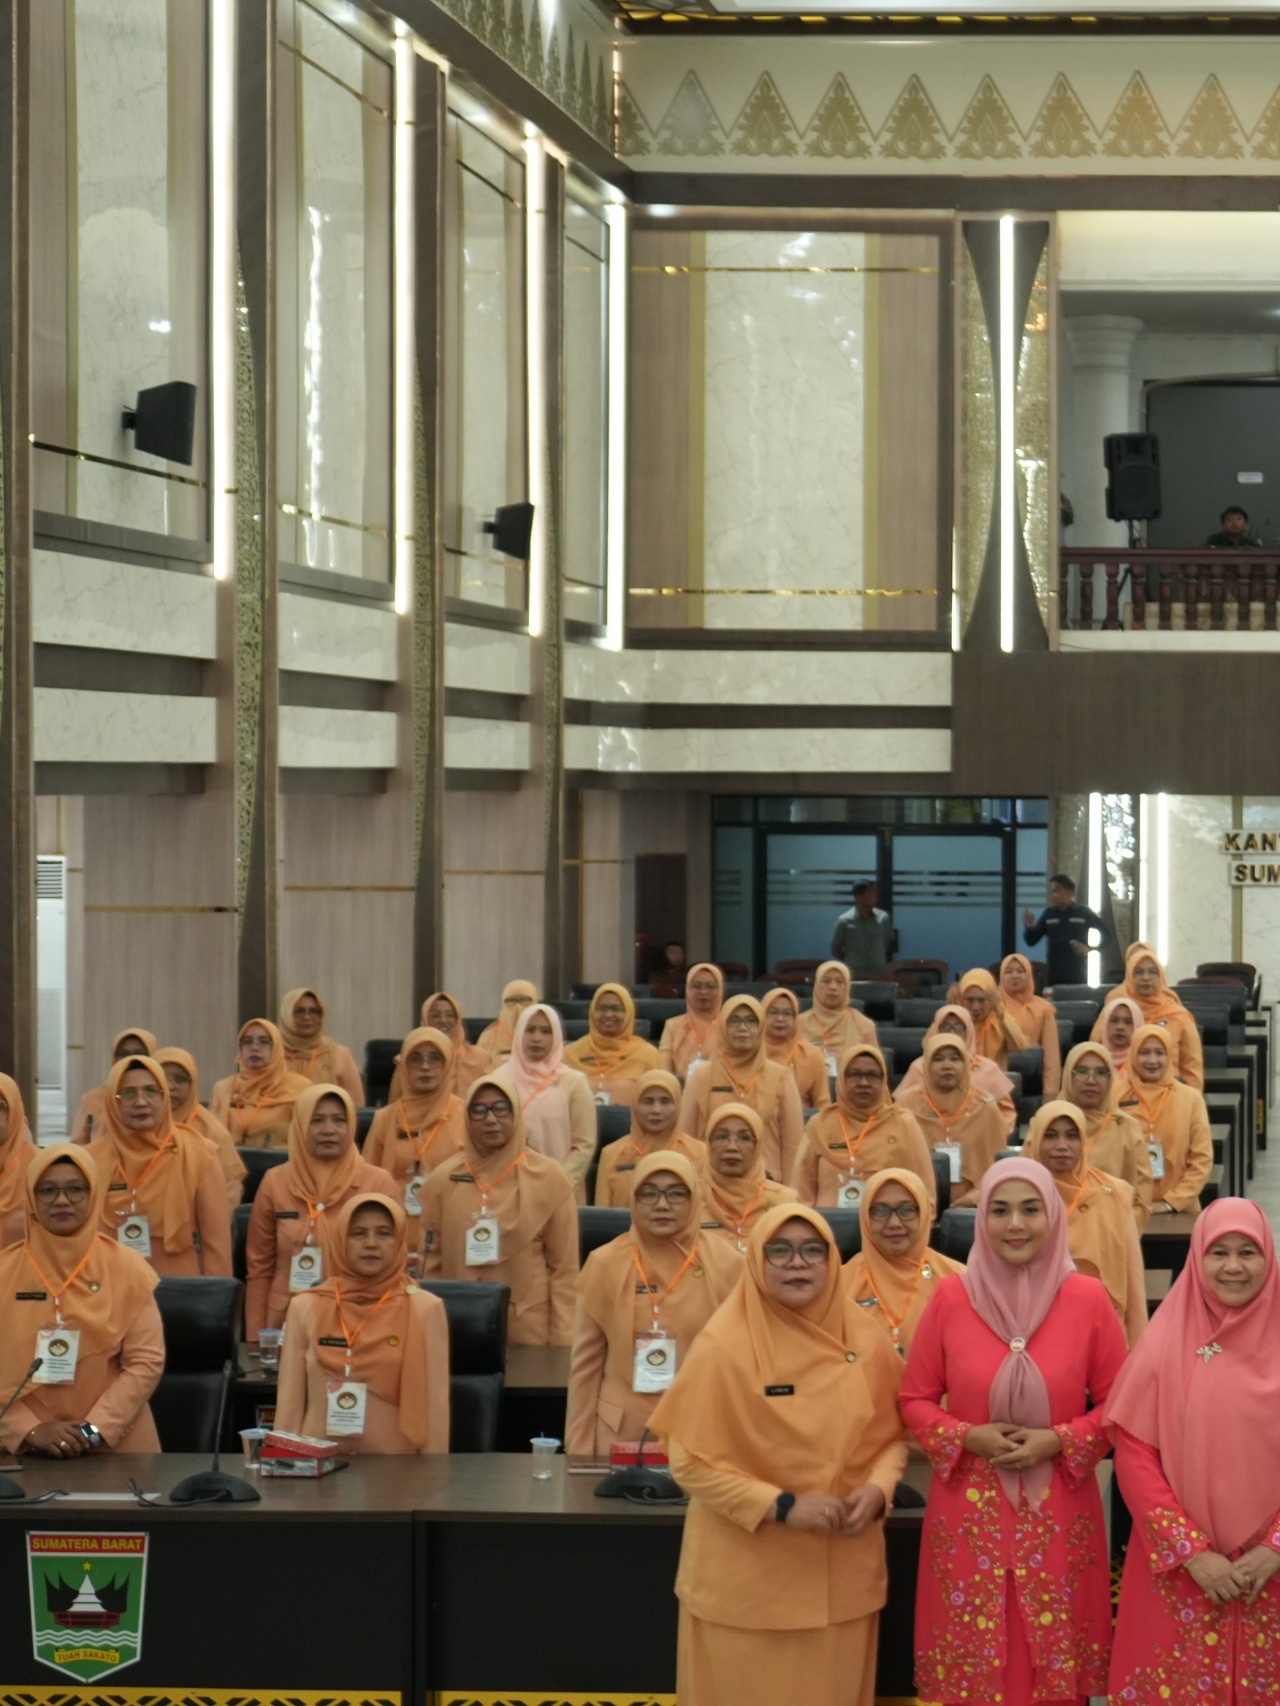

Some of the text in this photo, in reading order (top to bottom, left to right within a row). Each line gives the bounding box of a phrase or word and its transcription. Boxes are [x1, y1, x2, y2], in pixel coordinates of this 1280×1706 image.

[32, 1537, 143, 1550] SUMATERA BARAT
[57, 1651, 117, 1663] TUAH SAKATO
